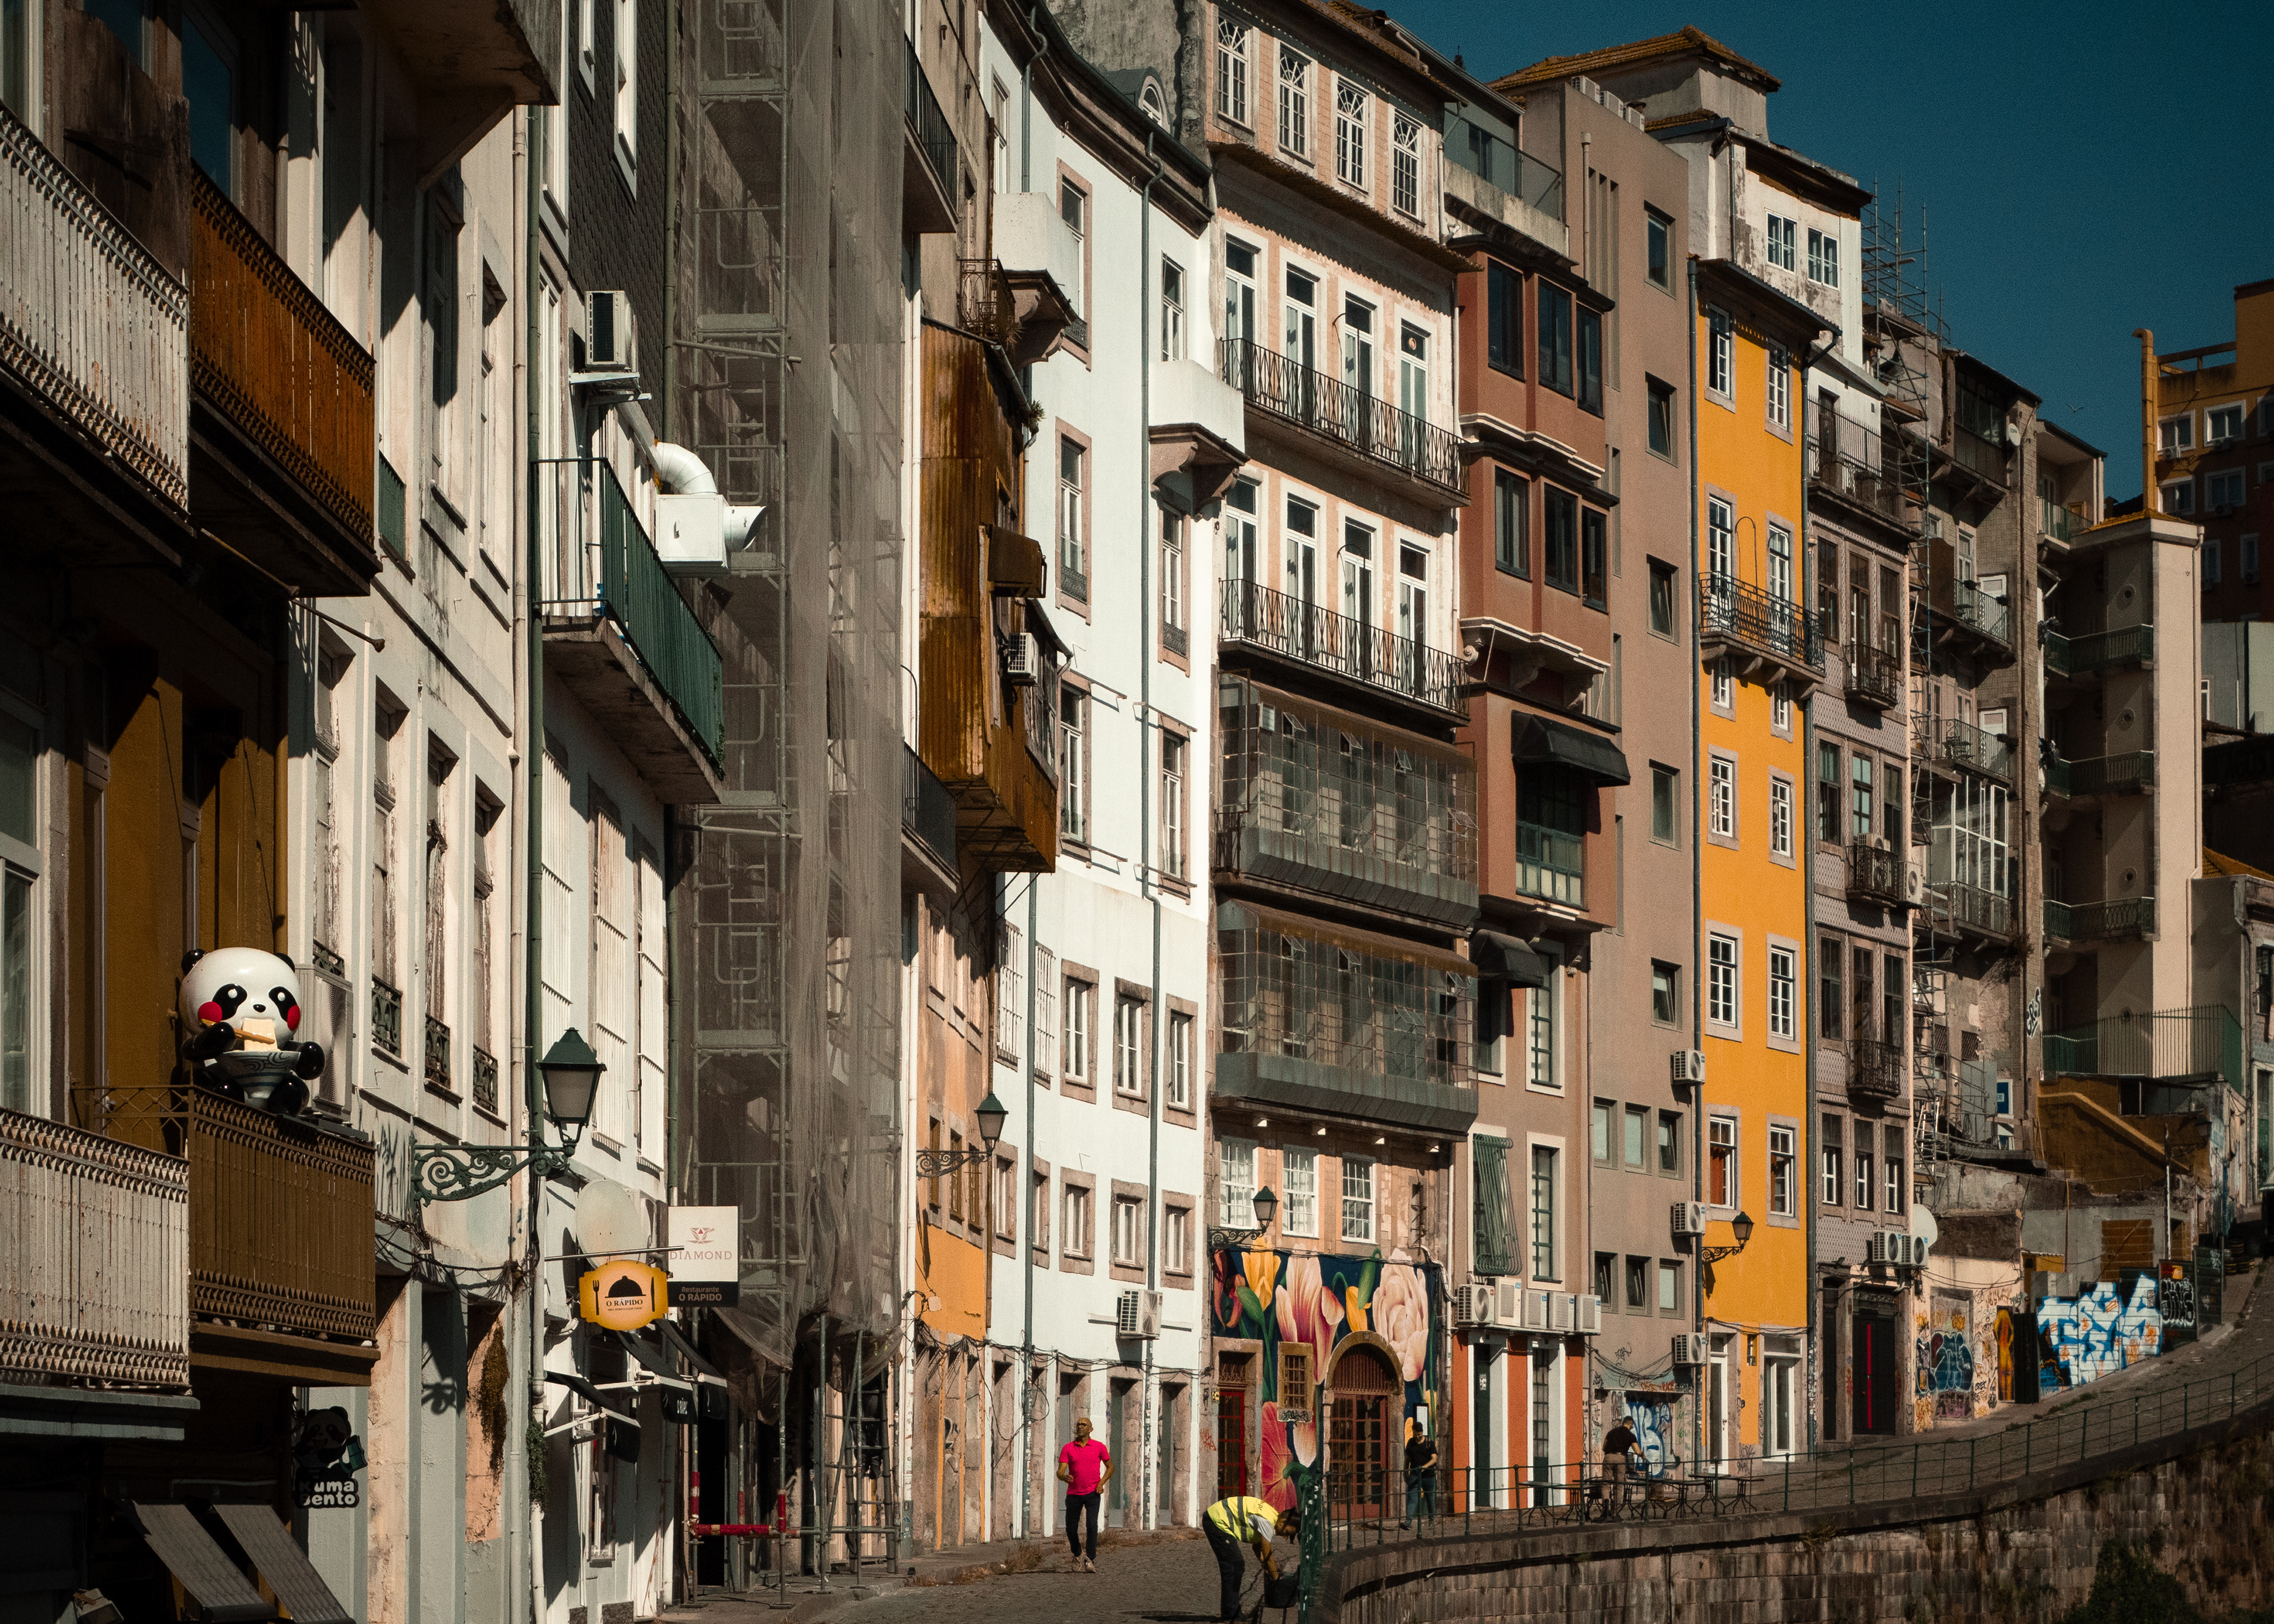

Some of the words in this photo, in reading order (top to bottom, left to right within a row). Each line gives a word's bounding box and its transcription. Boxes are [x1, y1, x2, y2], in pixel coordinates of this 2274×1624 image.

[669, 1251, 733, 1260] DIAMOND
[688, 1292, 722, 1301] RÁPIDO
[298, 1481, 355, 1493] Kuma
[298, 1491, 356, 1506] Bento
